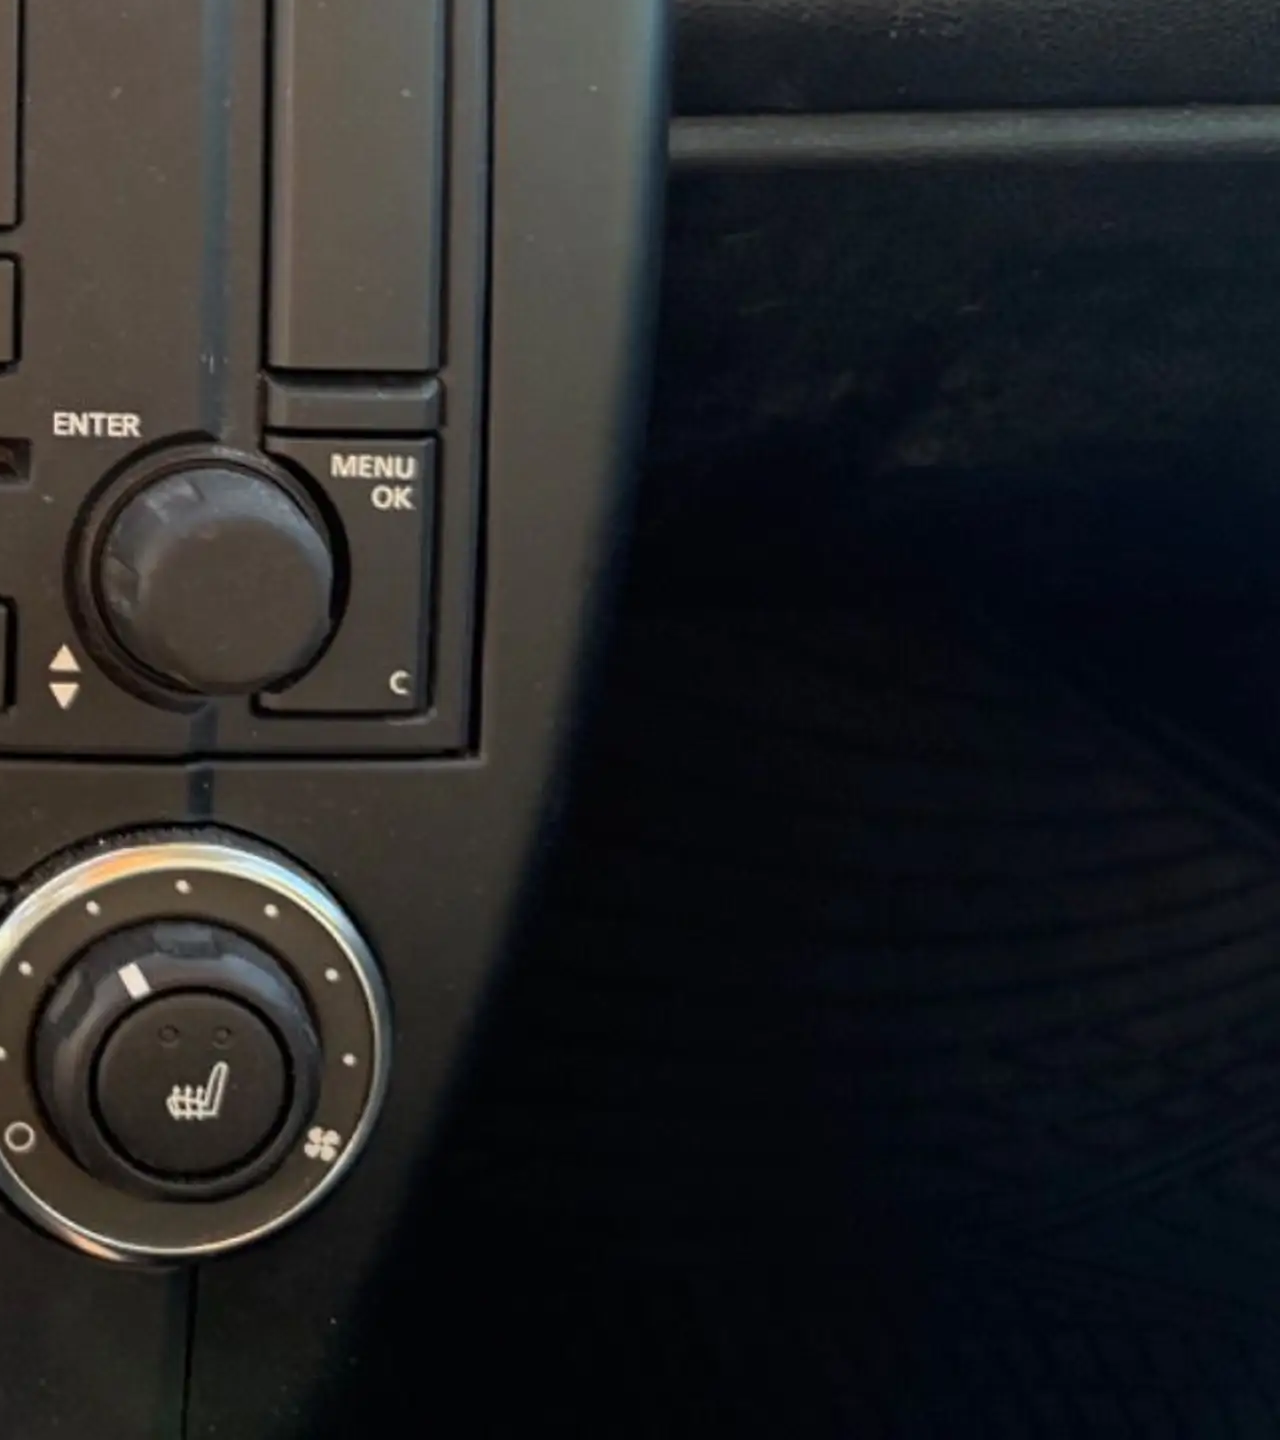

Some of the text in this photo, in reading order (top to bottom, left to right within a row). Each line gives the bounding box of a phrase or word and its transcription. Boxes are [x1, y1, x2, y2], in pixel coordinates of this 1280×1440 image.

[52, 412, 141, 438] ENTER
[330, 453, 416, 479] MENU
[370, 484, 415, 510] OK
[388, 670, 410, 696] C
